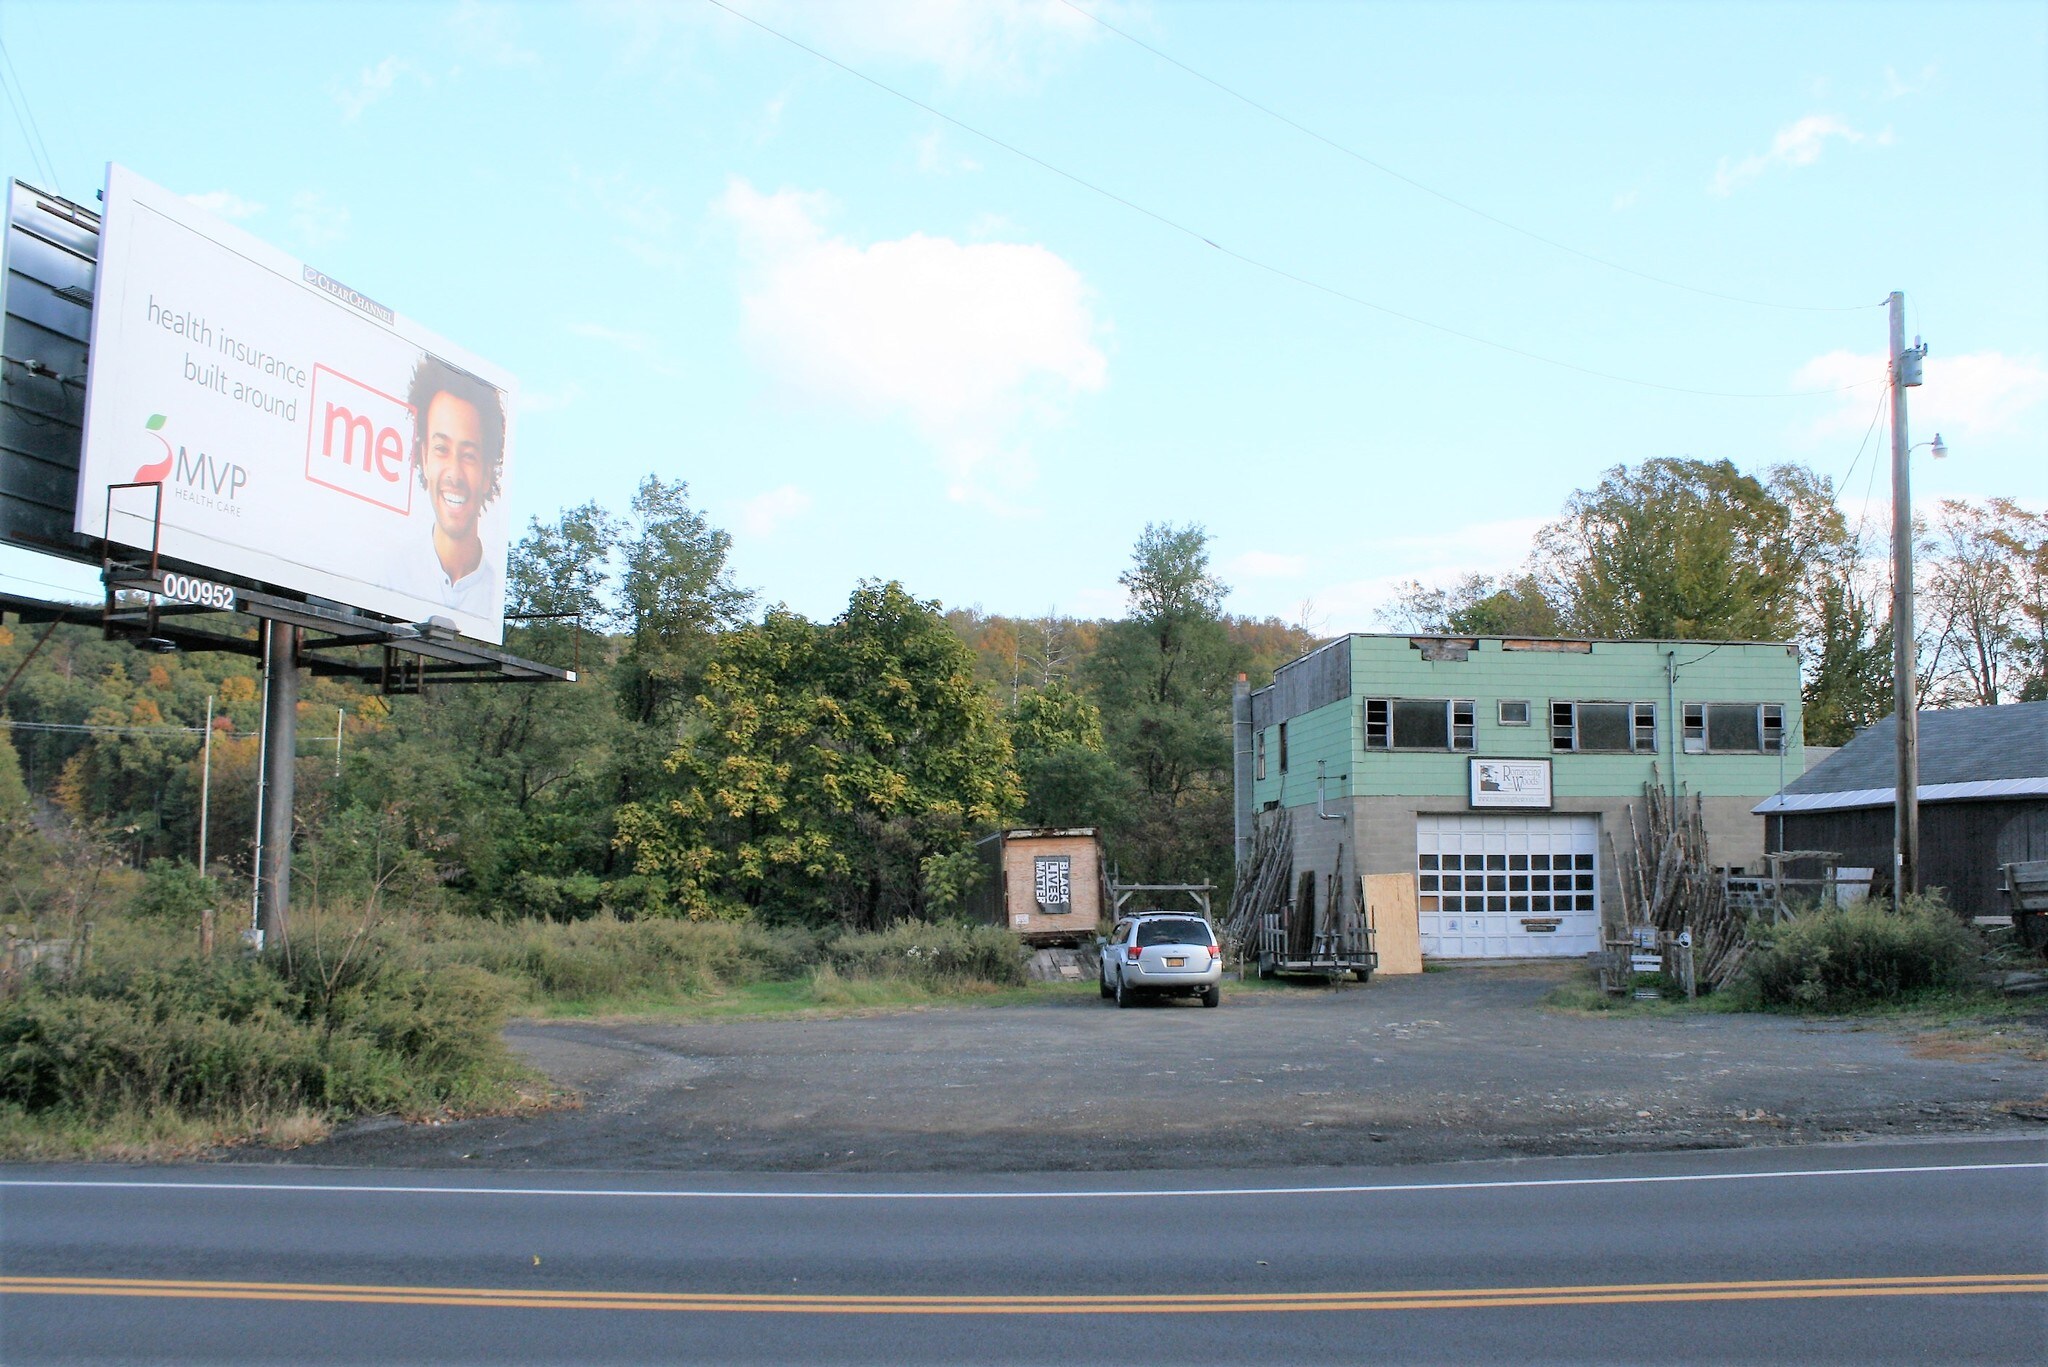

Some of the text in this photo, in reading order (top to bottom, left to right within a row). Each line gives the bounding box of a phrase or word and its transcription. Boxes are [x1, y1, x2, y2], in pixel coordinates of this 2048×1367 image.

[148, 294, 306, 388] health insurance
[184, 352, 297, 422] built around
[322, 401, 403, 482] me
[176, 446, 247, 500] MVP
[175, 488, 241, 517] HEALTH CARE
[163, 573, 234, 610] 000952
[1035, 861, 1046, 904] MATTER
[1047, 861, 1059, 903] LIVES
[1059, 861, 1069, 904] BLACK
